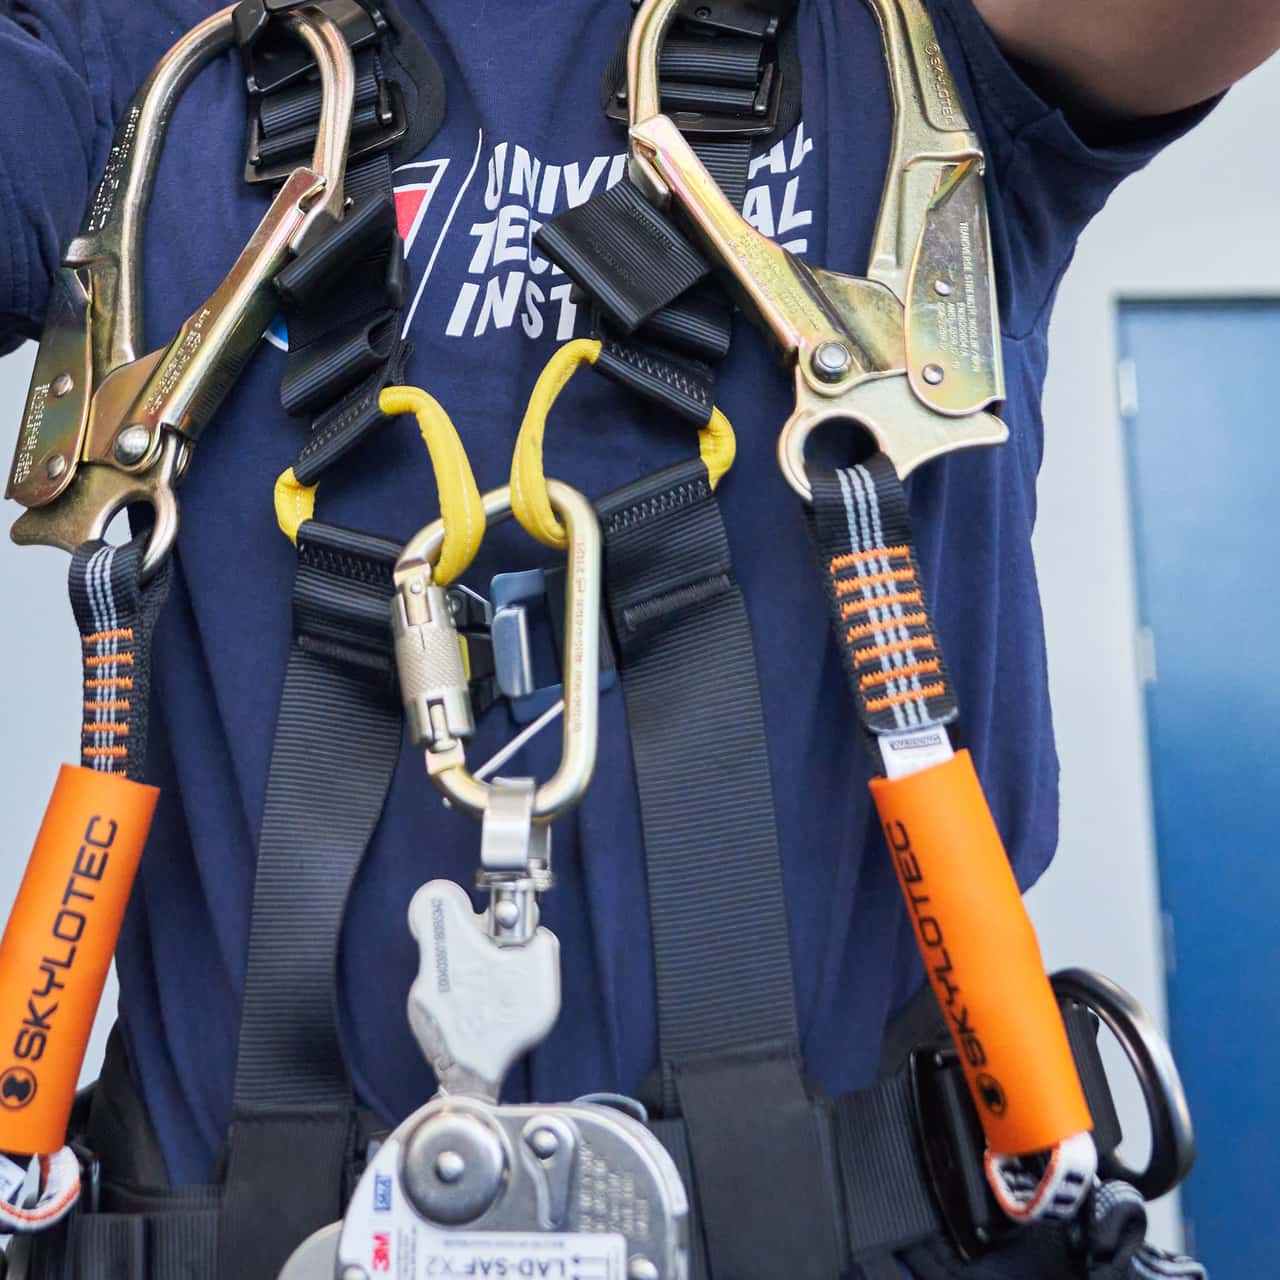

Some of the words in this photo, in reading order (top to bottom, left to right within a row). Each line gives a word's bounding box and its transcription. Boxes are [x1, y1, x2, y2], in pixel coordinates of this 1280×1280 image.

[12, 815, 119, 1062] SKYLOTEC
[885, 819, 987, 1068] SKYLOTEC
[372, 1231, 391, 1272] 3M
